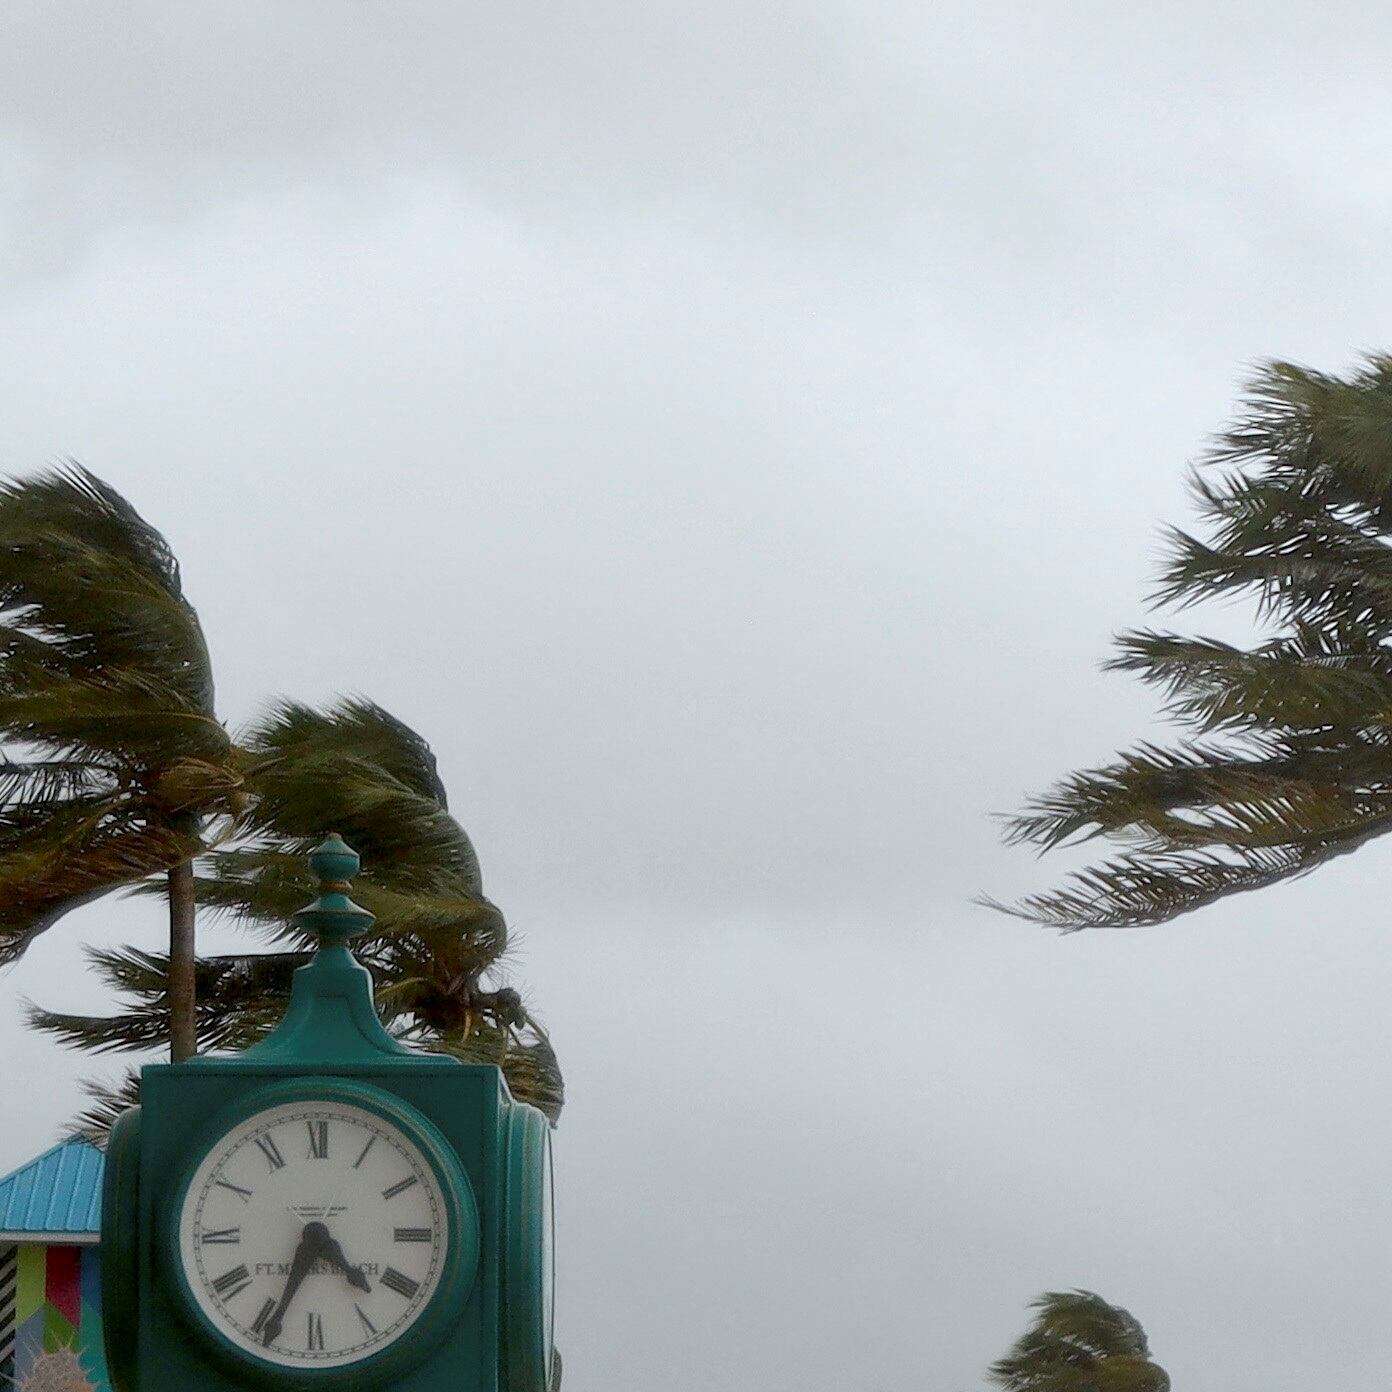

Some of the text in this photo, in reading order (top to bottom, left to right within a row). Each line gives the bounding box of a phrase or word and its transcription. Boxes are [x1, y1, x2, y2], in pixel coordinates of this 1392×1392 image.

[254, 1132, 286, 1174] XI
[306, 1120, 329, 1159] XII
[353, 1135, 377, 1169] I
[216, 1172, 253, 1204] X
[382, 1175, 418, 1200] II
[201, 1225, 240, 1244] IX
[393, 1228, 432, 1243] III
[211, 1263, 254, 1303] VIII
[307, 1312, 325, 1350] VI
[354, 1302, 379, 1339] V
